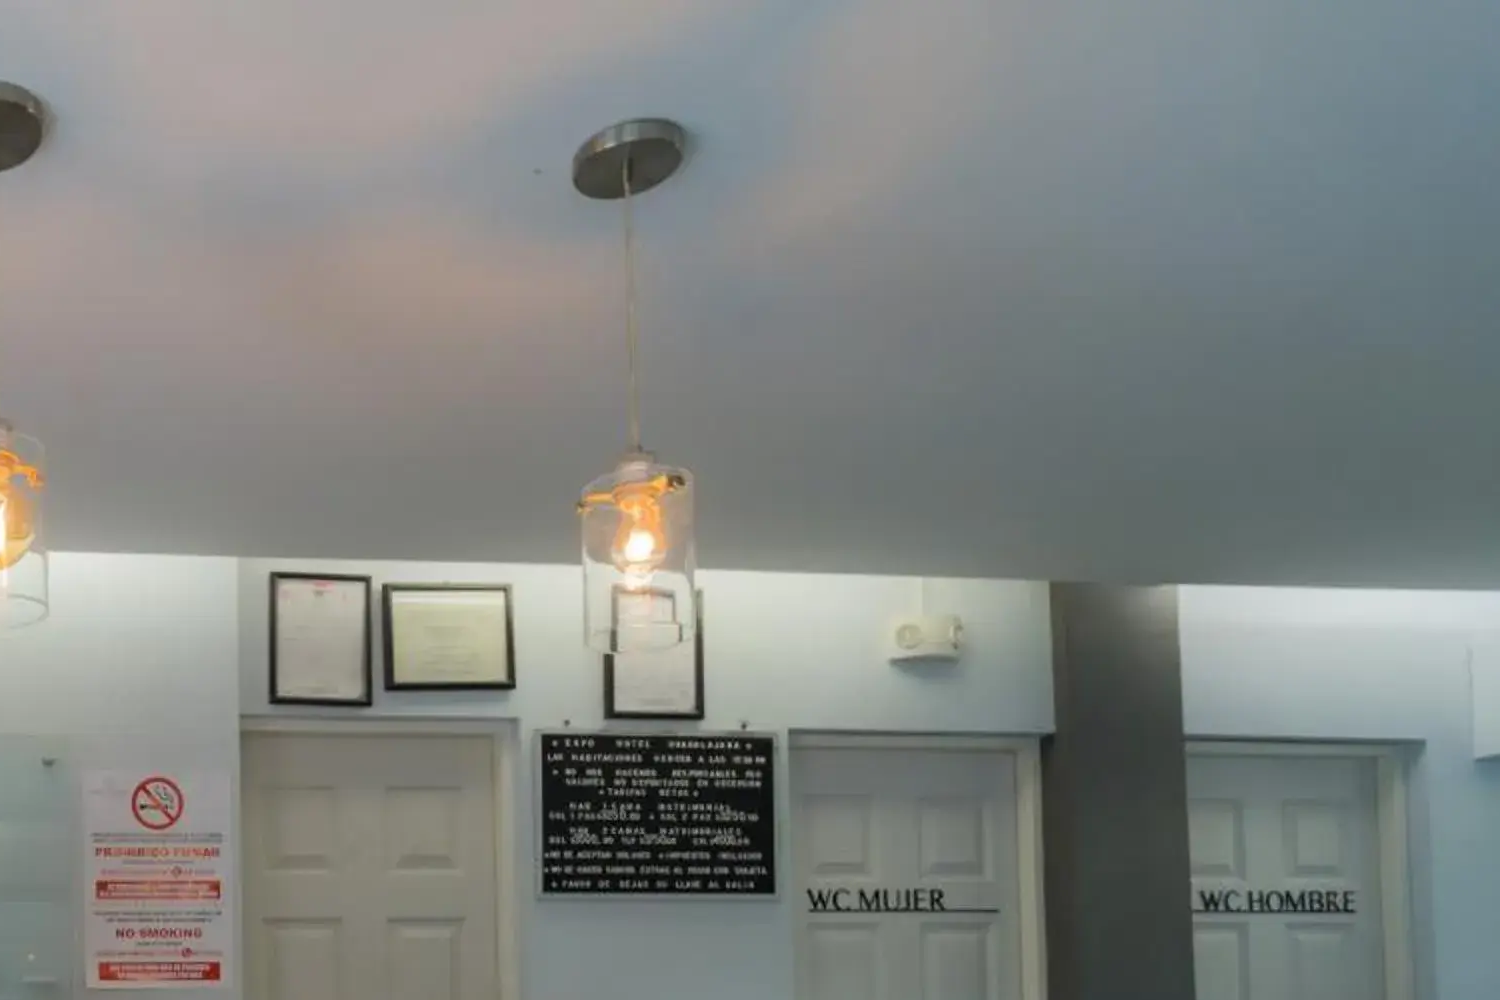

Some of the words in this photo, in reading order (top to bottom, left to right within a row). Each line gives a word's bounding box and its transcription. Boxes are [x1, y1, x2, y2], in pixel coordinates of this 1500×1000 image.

[859, 887, 947, 912] MUJER
[1247, 890, 1357, 913] HOMBRE
[116, 928, 135, 939] NO
[140, 928, 202, 939] SMOKING
